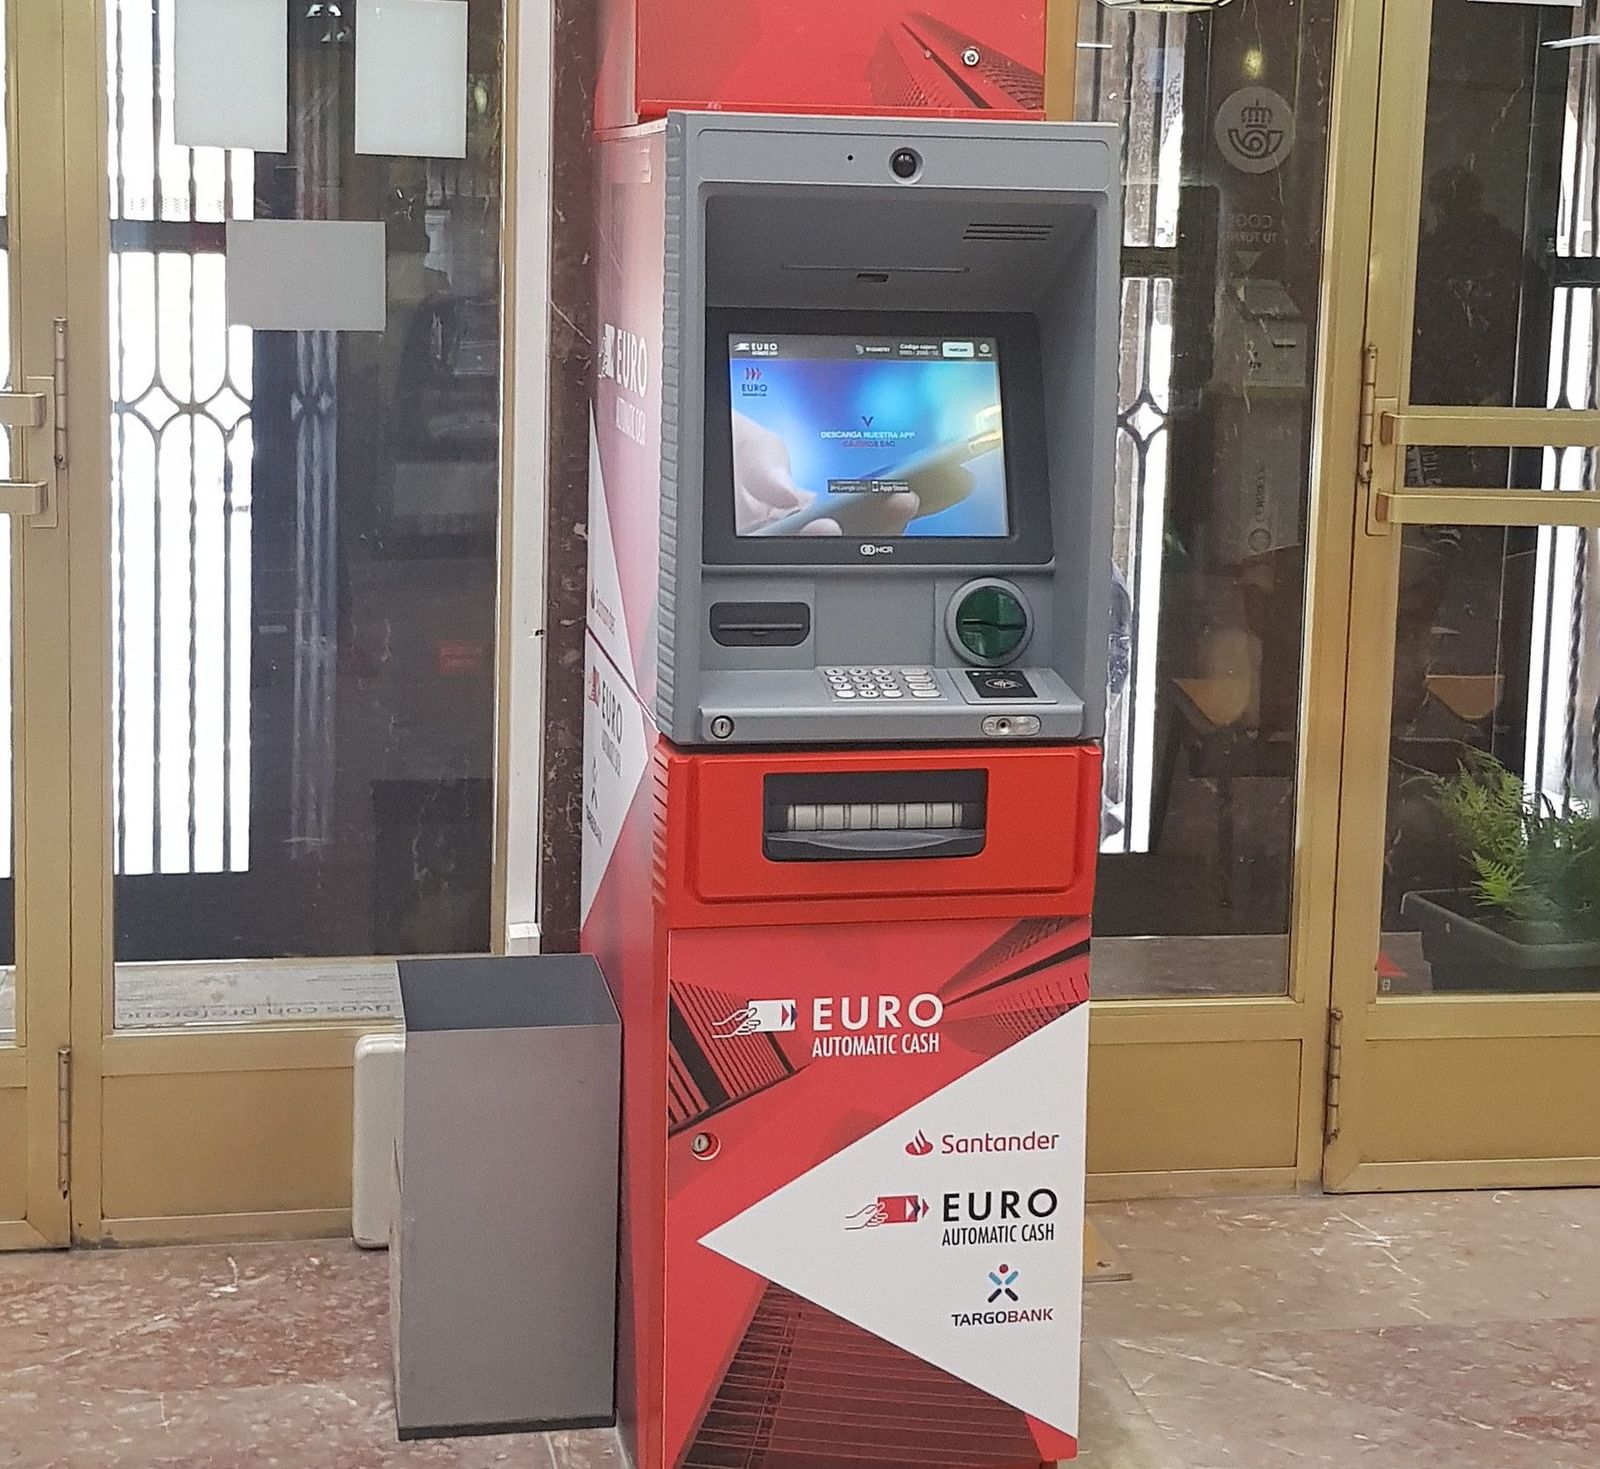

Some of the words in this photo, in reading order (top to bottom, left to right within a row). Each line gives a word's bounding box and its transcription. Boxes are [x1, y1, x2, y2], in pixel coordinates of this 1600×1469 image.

[751, 342, 778, 351] EURO
[616, 328, 649, 398] EURO
[741, 383, 768, 392] EURO
[820, 431, 862, 439] DESCARGA
[863, 431, 898, 439] NUESTRA
[875, 545, 894, 554] NCR
[601, 679, 623, 745] EURO
[812, 992, 943, 1031] EURO
[811, 1034, 898, 1057] AUTOMATIC
[901, 1033, 940, 1054] CASH
[940, 1131, 1060, 1154] Santander
[942, 1188, 1058, 1222] EURO
[941, 1225, 1017, 1246] AUTOMATIC
[1021, 1223, 1055, 1243] CASH
[951, 1308, 1054, 1327] TARGOBANK
